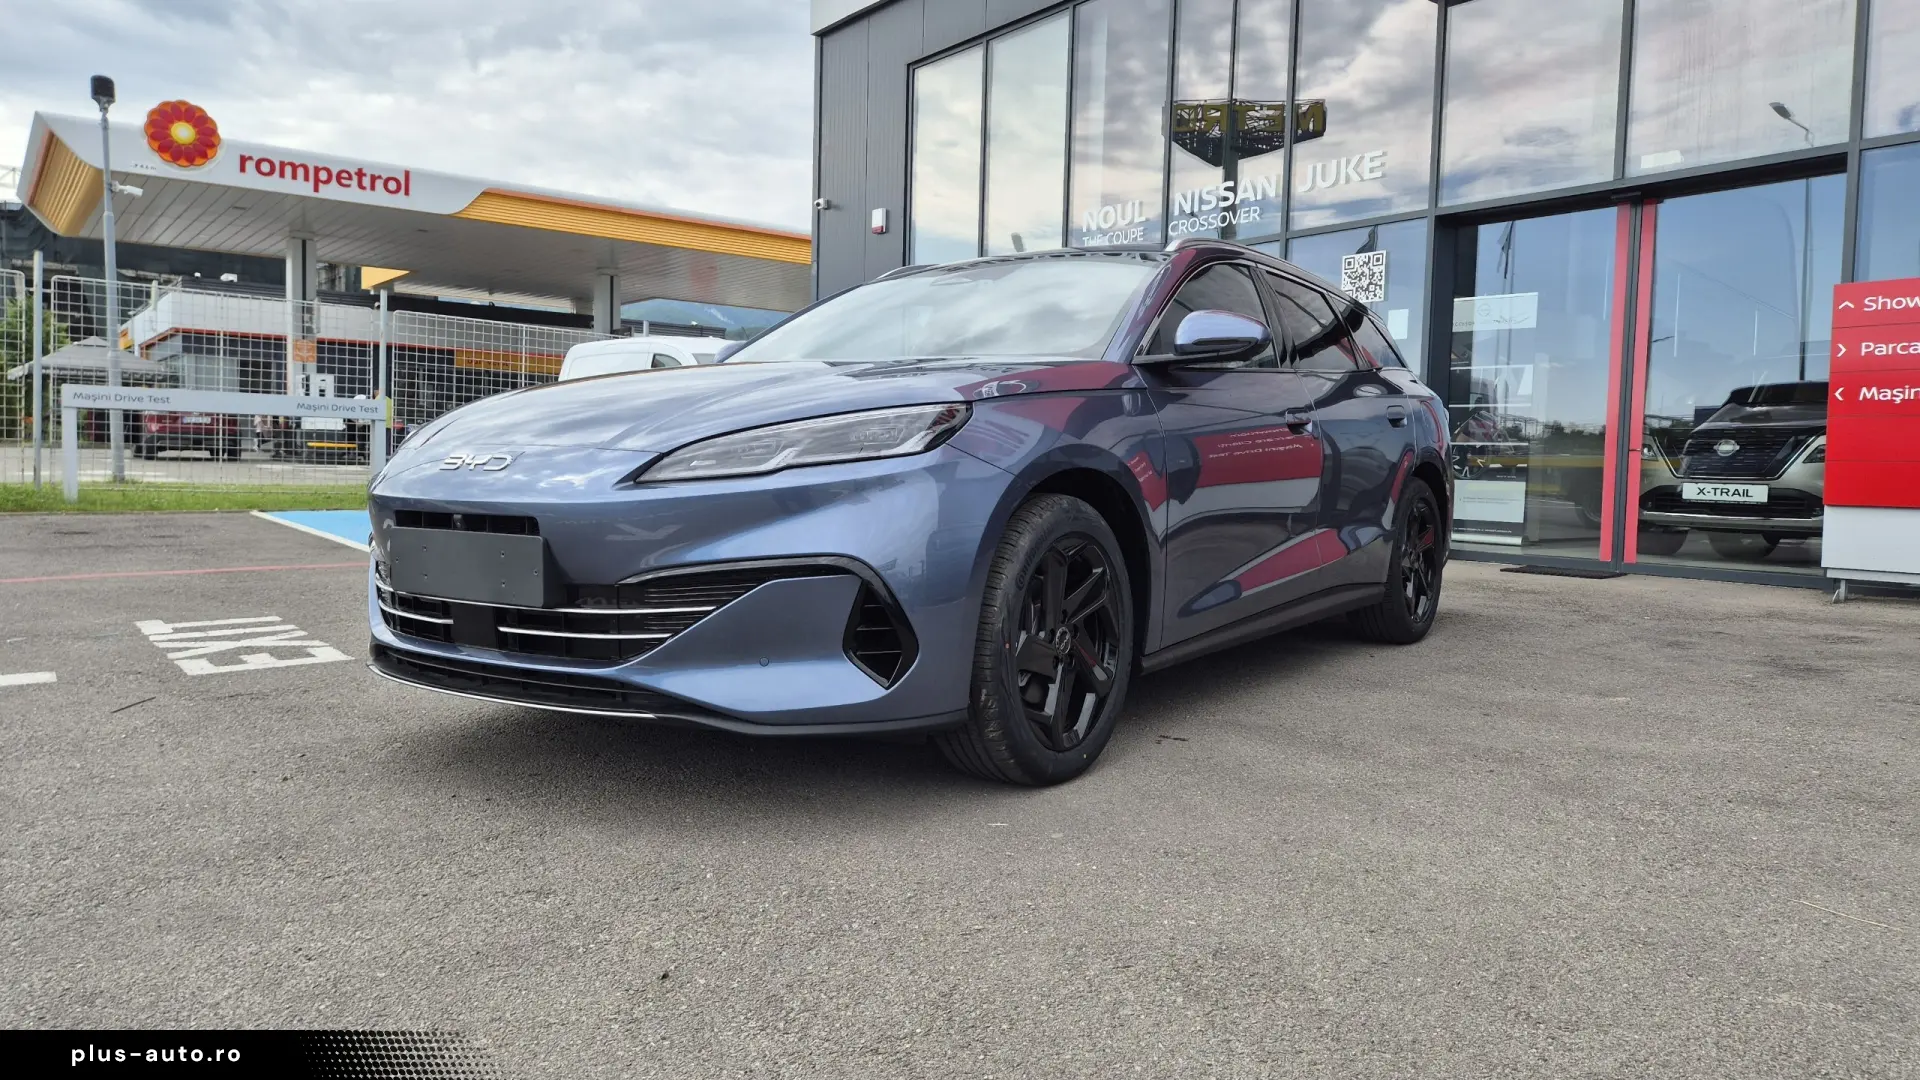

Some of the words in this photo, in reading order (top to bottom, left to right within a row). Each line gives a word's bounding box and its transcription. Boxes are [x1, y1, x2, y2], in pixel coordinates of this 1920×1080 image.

[239, 154, 410, 197] rompetrol
[1082, 200, 1147, 232] NOUL
[1173, 174, 1277, 216] NISSAN
[1299, 150, 1384, 193] JUKE
[1106, 226, 1145, 245] COUPE
[1168, 206, 1262, 236] CROSSOVER
[1863, 295, 1920, 311] Show
[1860, 342, 1920, 356] Parca
[114, 393, 144, 403] Drive
[146, 395, 171, 404] Test
[331, 404, 356, 412] Drive
[358, 405, 379, 413] Test
[439, 453, 513, 471] BYD
[1696, 486, 1754, 498] X-TRAIL
